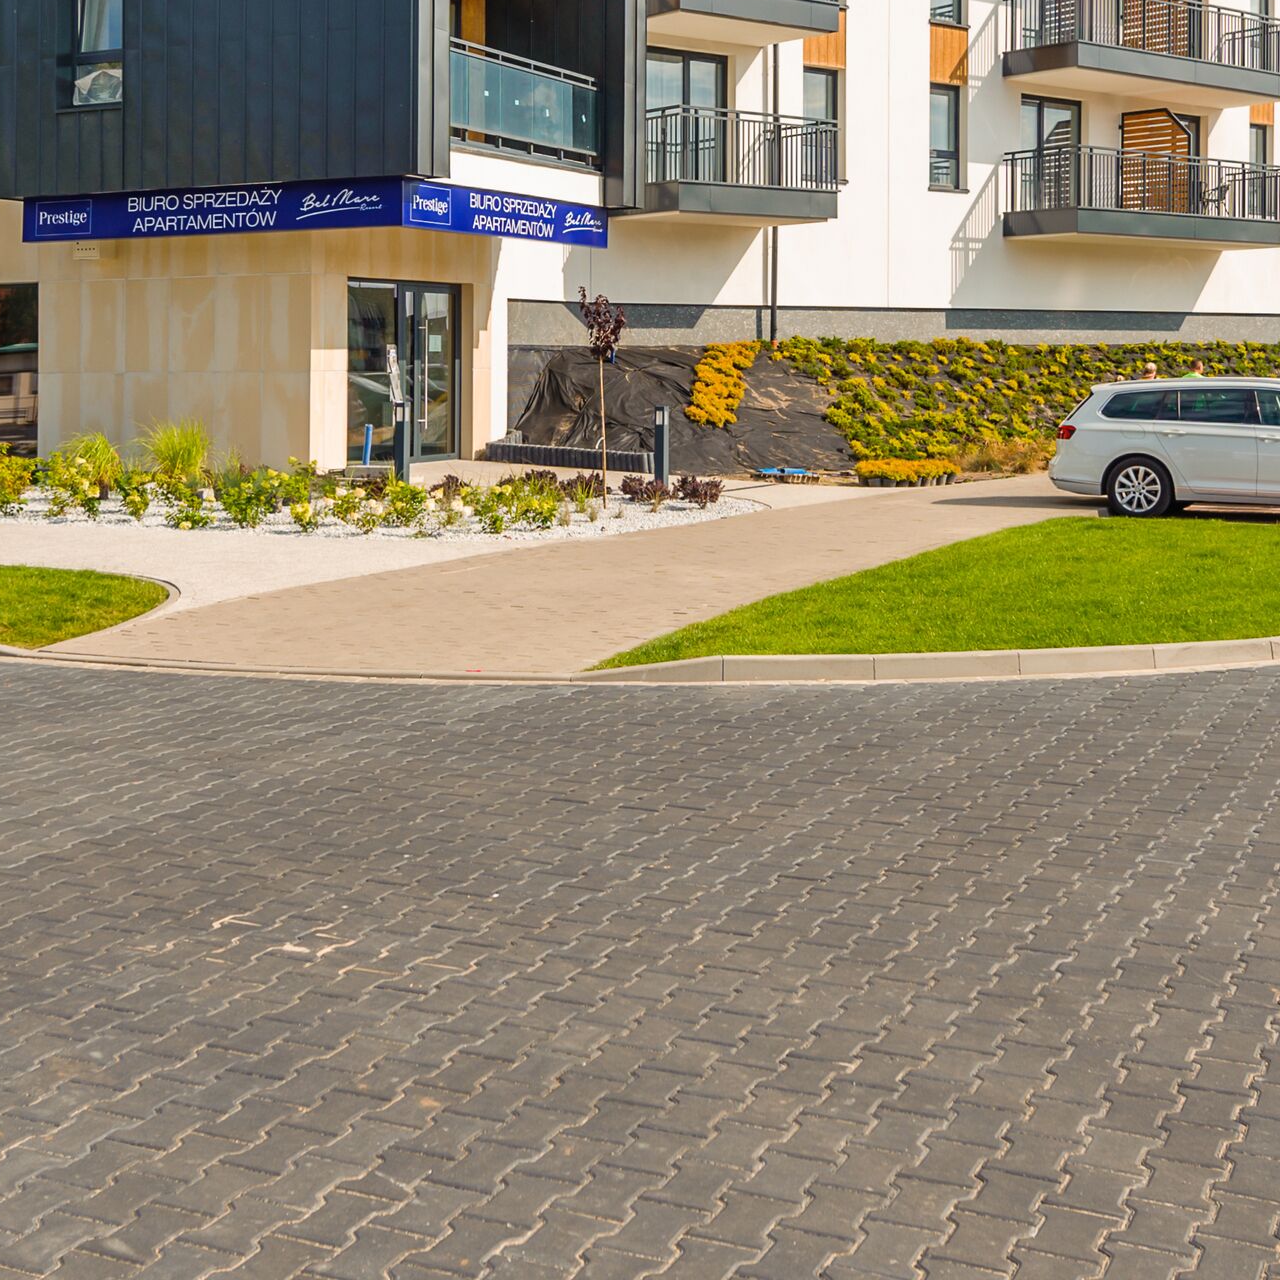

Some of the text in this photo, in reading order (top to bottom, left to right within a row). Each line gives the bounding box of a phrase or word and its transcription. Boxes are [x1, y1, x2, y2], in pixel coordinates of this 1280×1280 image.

[128, 186, 282, 212] BIURO SPRZEDAŻY
[300, 188, 380, 211] Bel Mare
[413, 195, 448, 215] Prestige
[470, 193, 557, 219] BIURO SPRZEDAŻY
[39, 210, 88, 227] Prestige
[132, 208, 277, 233] APARTAMENTÓW
[472, 215, 554, 238] APARTAMENTÓW
[564, 211, 581, 227] Bel
